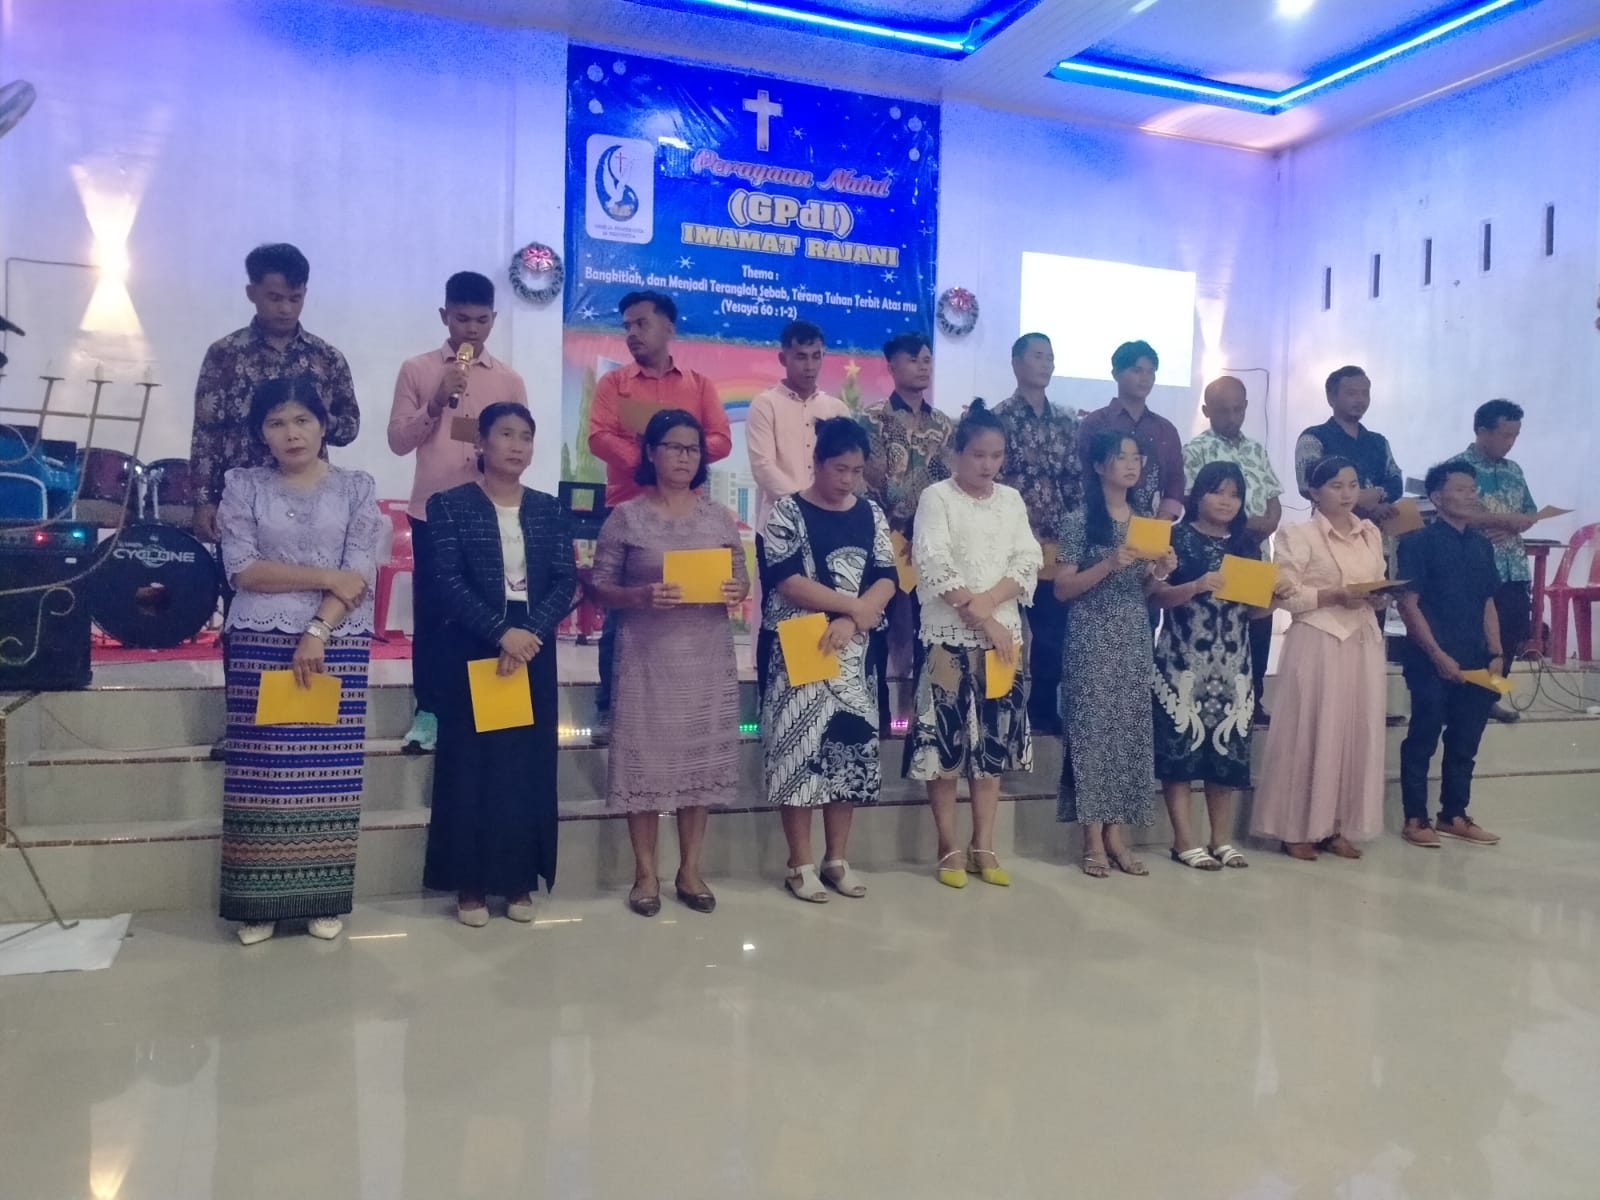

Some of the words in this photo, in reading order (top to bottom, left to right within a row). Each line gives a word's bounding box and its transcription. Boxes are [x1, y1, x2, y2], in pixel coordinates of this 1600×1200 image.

[691, 149, 814, 187] Perayaan
[816, 168, 892, 197] Natal
[728, 188, 854, 239] (GPdI)
[681, 223, 800, 255] IMAMAT
[805, 238, 899, 267] RAJANI
[585, 266, 645, 286] Bangkitlah,
[647, 273, 667, 287] dan
[669, 275, 707, 292] Menjadi
[710, 280, 758, 297] Teranglah
[759, 283, 790, 301] Sebab,
[792, 288, 823, 305] Terang
[825, 292, 852, 306] Tuhan
[855, 294, 880, 309] Terbit
[881, 297, 901, 311] Atas
[903, 303, 918, 312] mu
[741, 265, 773, 280] Thema
[721, 299, 758, 316] (Yesaya
[760, 305, 773, 316] 60
[780, 306, 798, 320] 1-2)
[113, 548, 196, 563] CYCLONE
